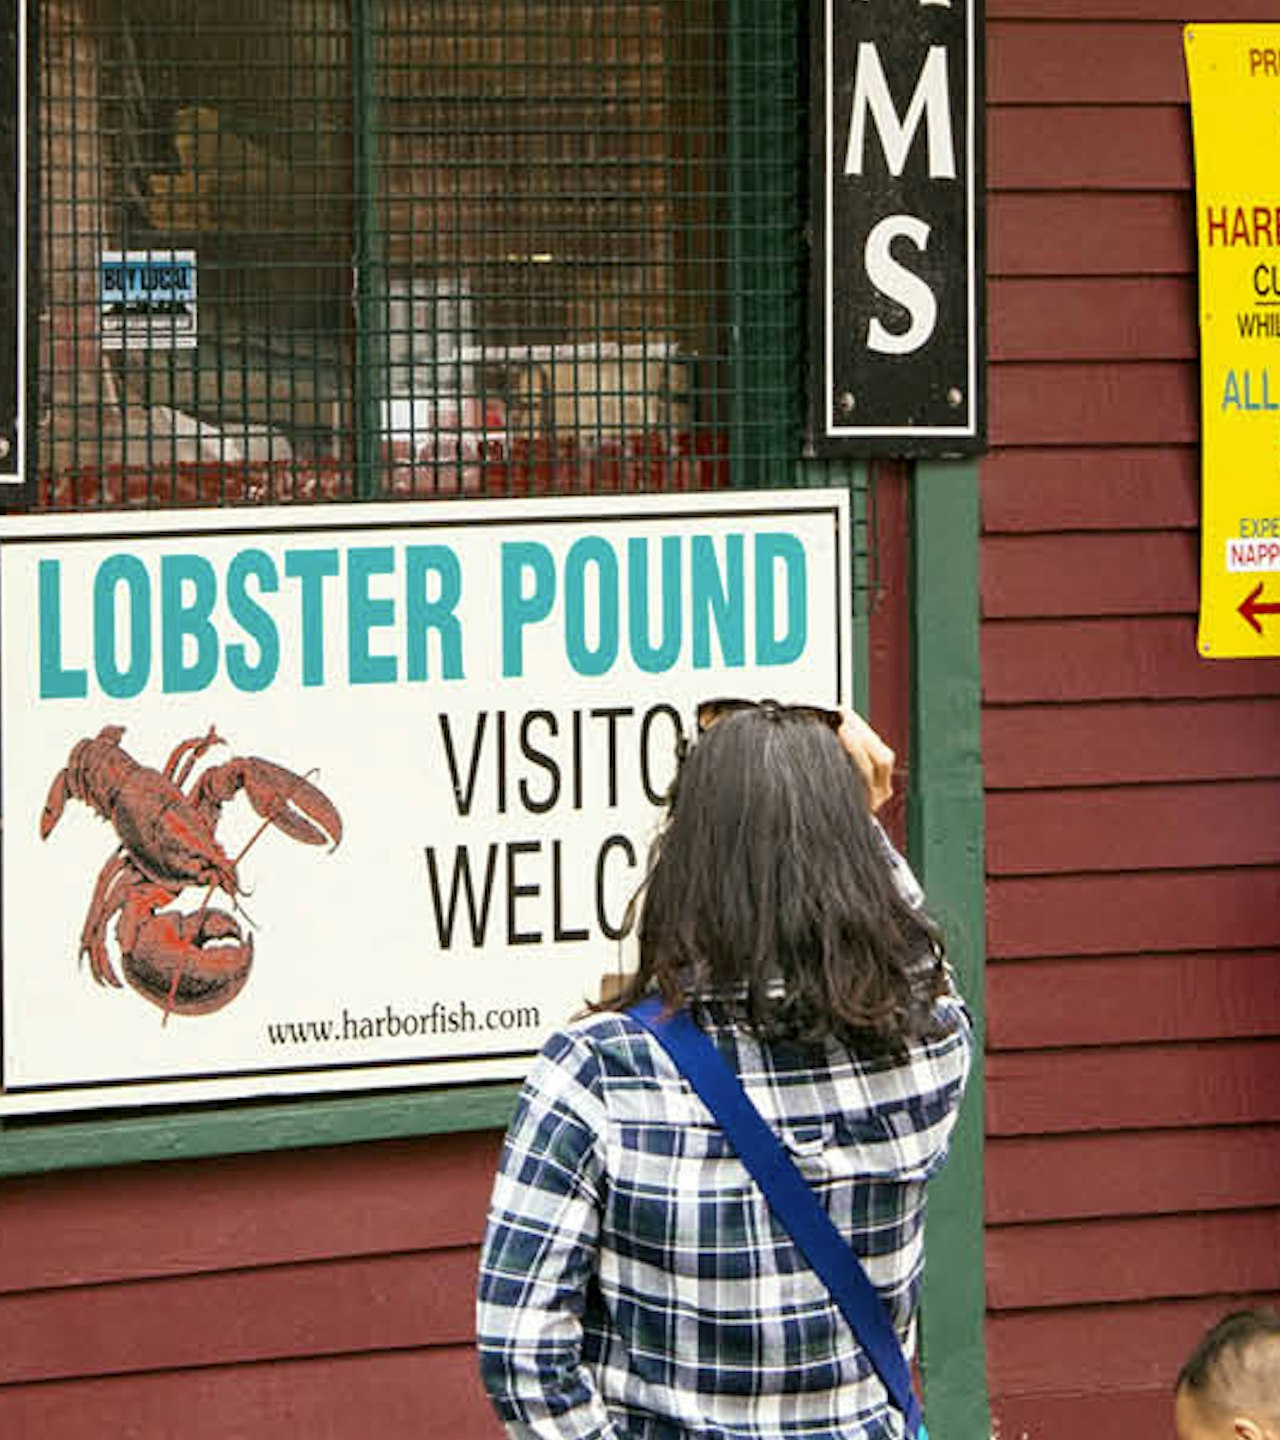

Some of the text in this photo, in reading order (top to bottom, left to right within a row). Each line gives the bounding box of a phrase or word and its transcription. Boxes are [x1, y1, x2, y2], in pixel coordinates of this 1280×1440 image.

[1222, 369, 1279, 412] ALL
[37, 532, 809, 700] LOBSTER POUND
[439, 704, 685, 816] VISITO
[425, 834, 636, 949] WELC
[269, 1001, 540, 1045] www.harborfish.com
